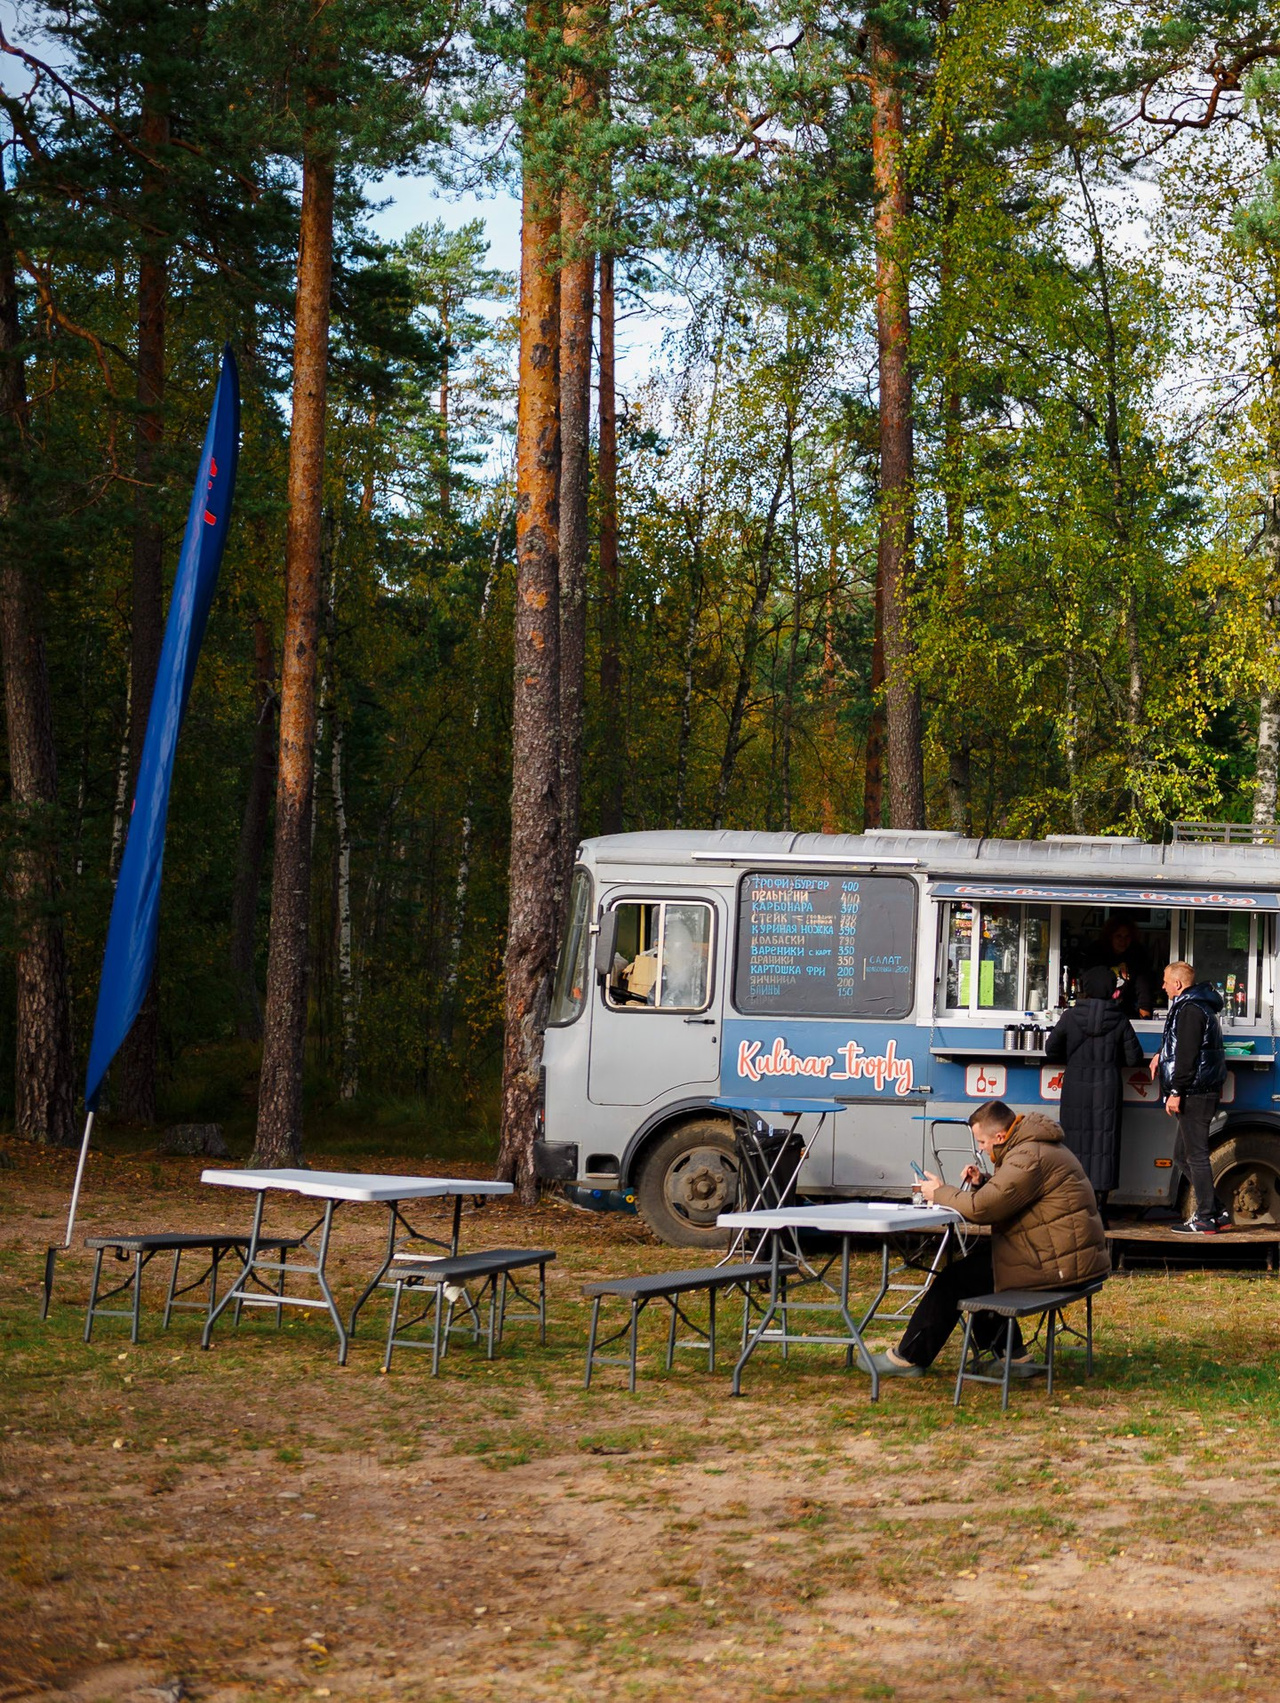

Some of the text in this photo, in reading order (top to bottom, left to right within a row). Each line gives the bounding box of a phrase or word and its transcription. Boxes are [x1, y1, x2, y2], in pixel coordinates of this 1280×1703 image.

[842, 881, 859, 892] 400
[840, 893, 860, 904] 400
[752, 902, 859, 914] КАРБОНАРА 370
[751, 924, 797, 934] КУРИНАЯ
[800, 925, 834, 935] НОЖКА
[751, 935, 855, 946] КОЛБАСКИ 790
[751, 945, 805, 956] ВАРЕНИКИ
[838, 946, 855, 956] 350
[750, 956, 855, 966] ДРАНИКИ 350
[869, 955, 901, 965] САЛАТ
[750, 965, 801, 975] КАРТОШКА
[806, 966, 826, 977] ФРИ
[837, 967, 855, 977] 200
[750, 976, 855, 987] ЯИЧНИЦА 200
[750, 985, 854, 997] БЛИНЫ 150
